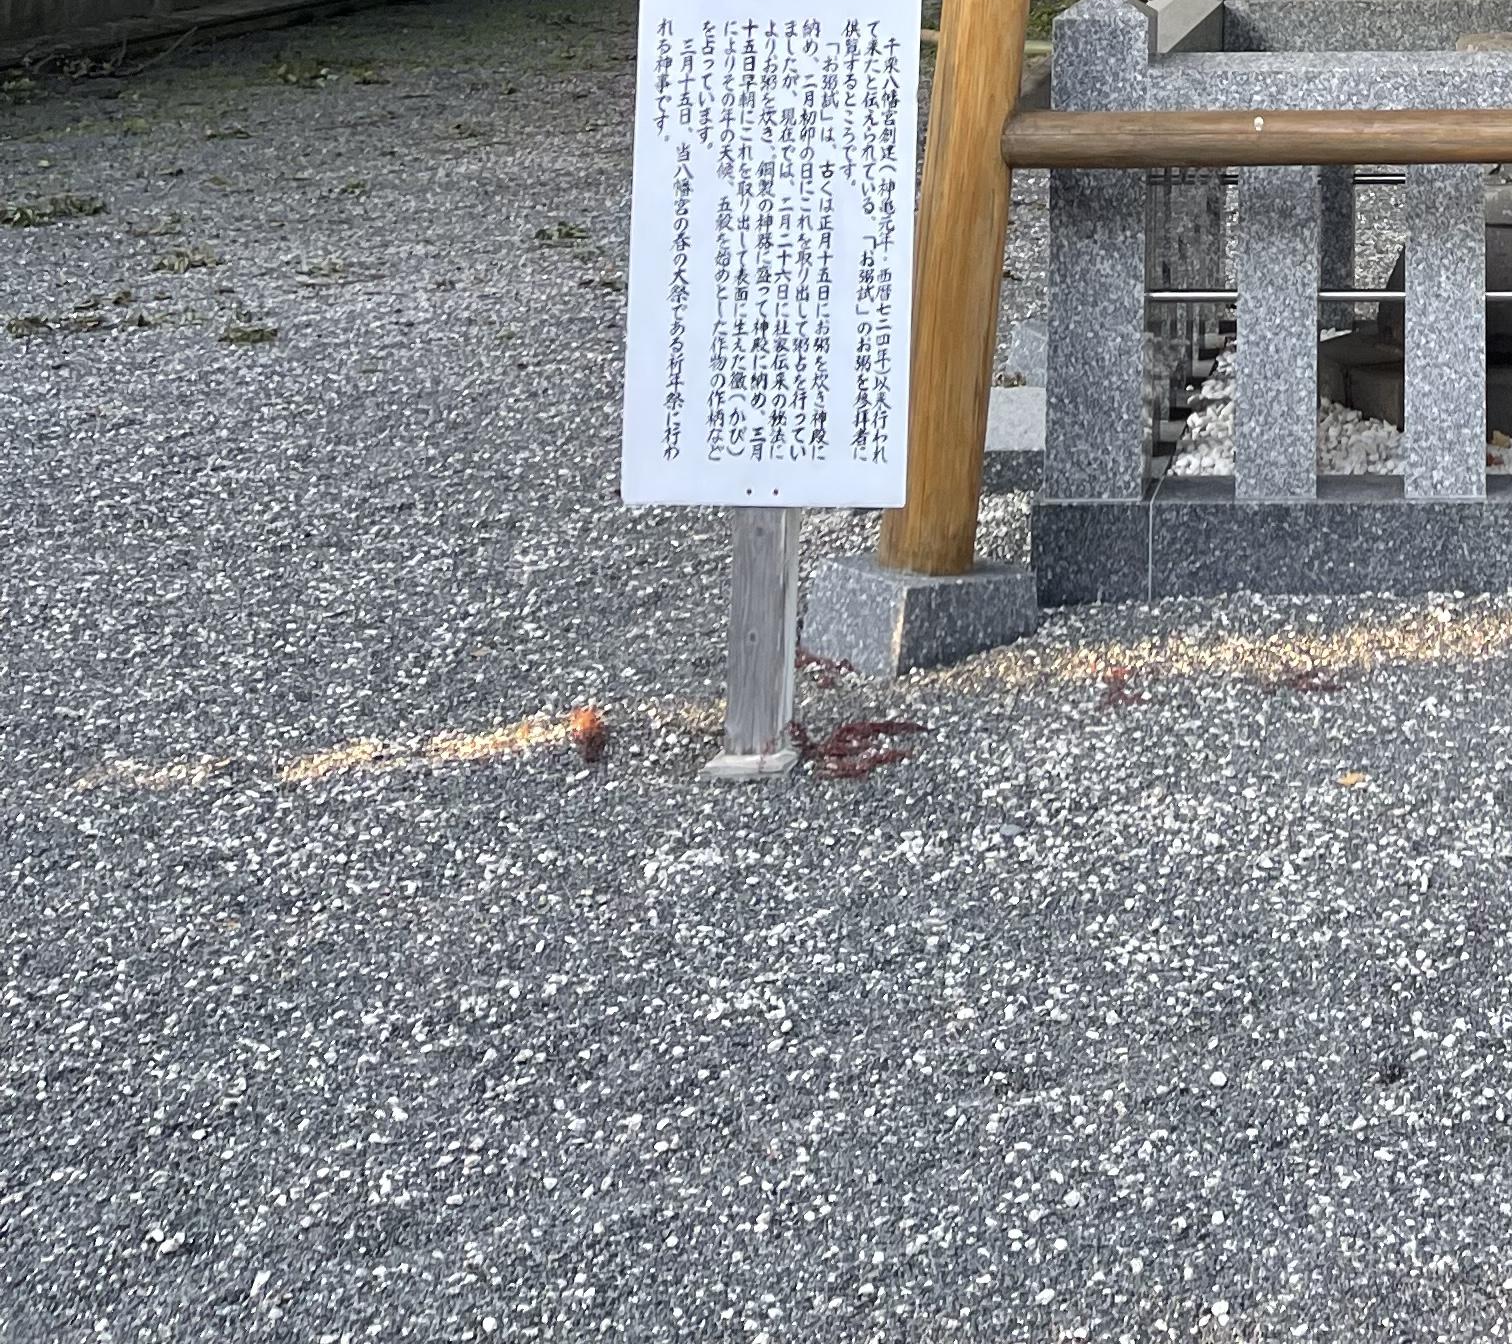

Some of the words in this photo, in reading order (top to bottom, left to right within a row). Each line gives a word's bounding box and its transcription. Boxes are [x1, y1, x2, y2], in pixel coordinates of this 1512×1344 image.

[653, 18, 673, 143] れる神事です。
[698, 20, 716, 152] を占っています。
[839, 20, 861, 187] 供覧するところです。
